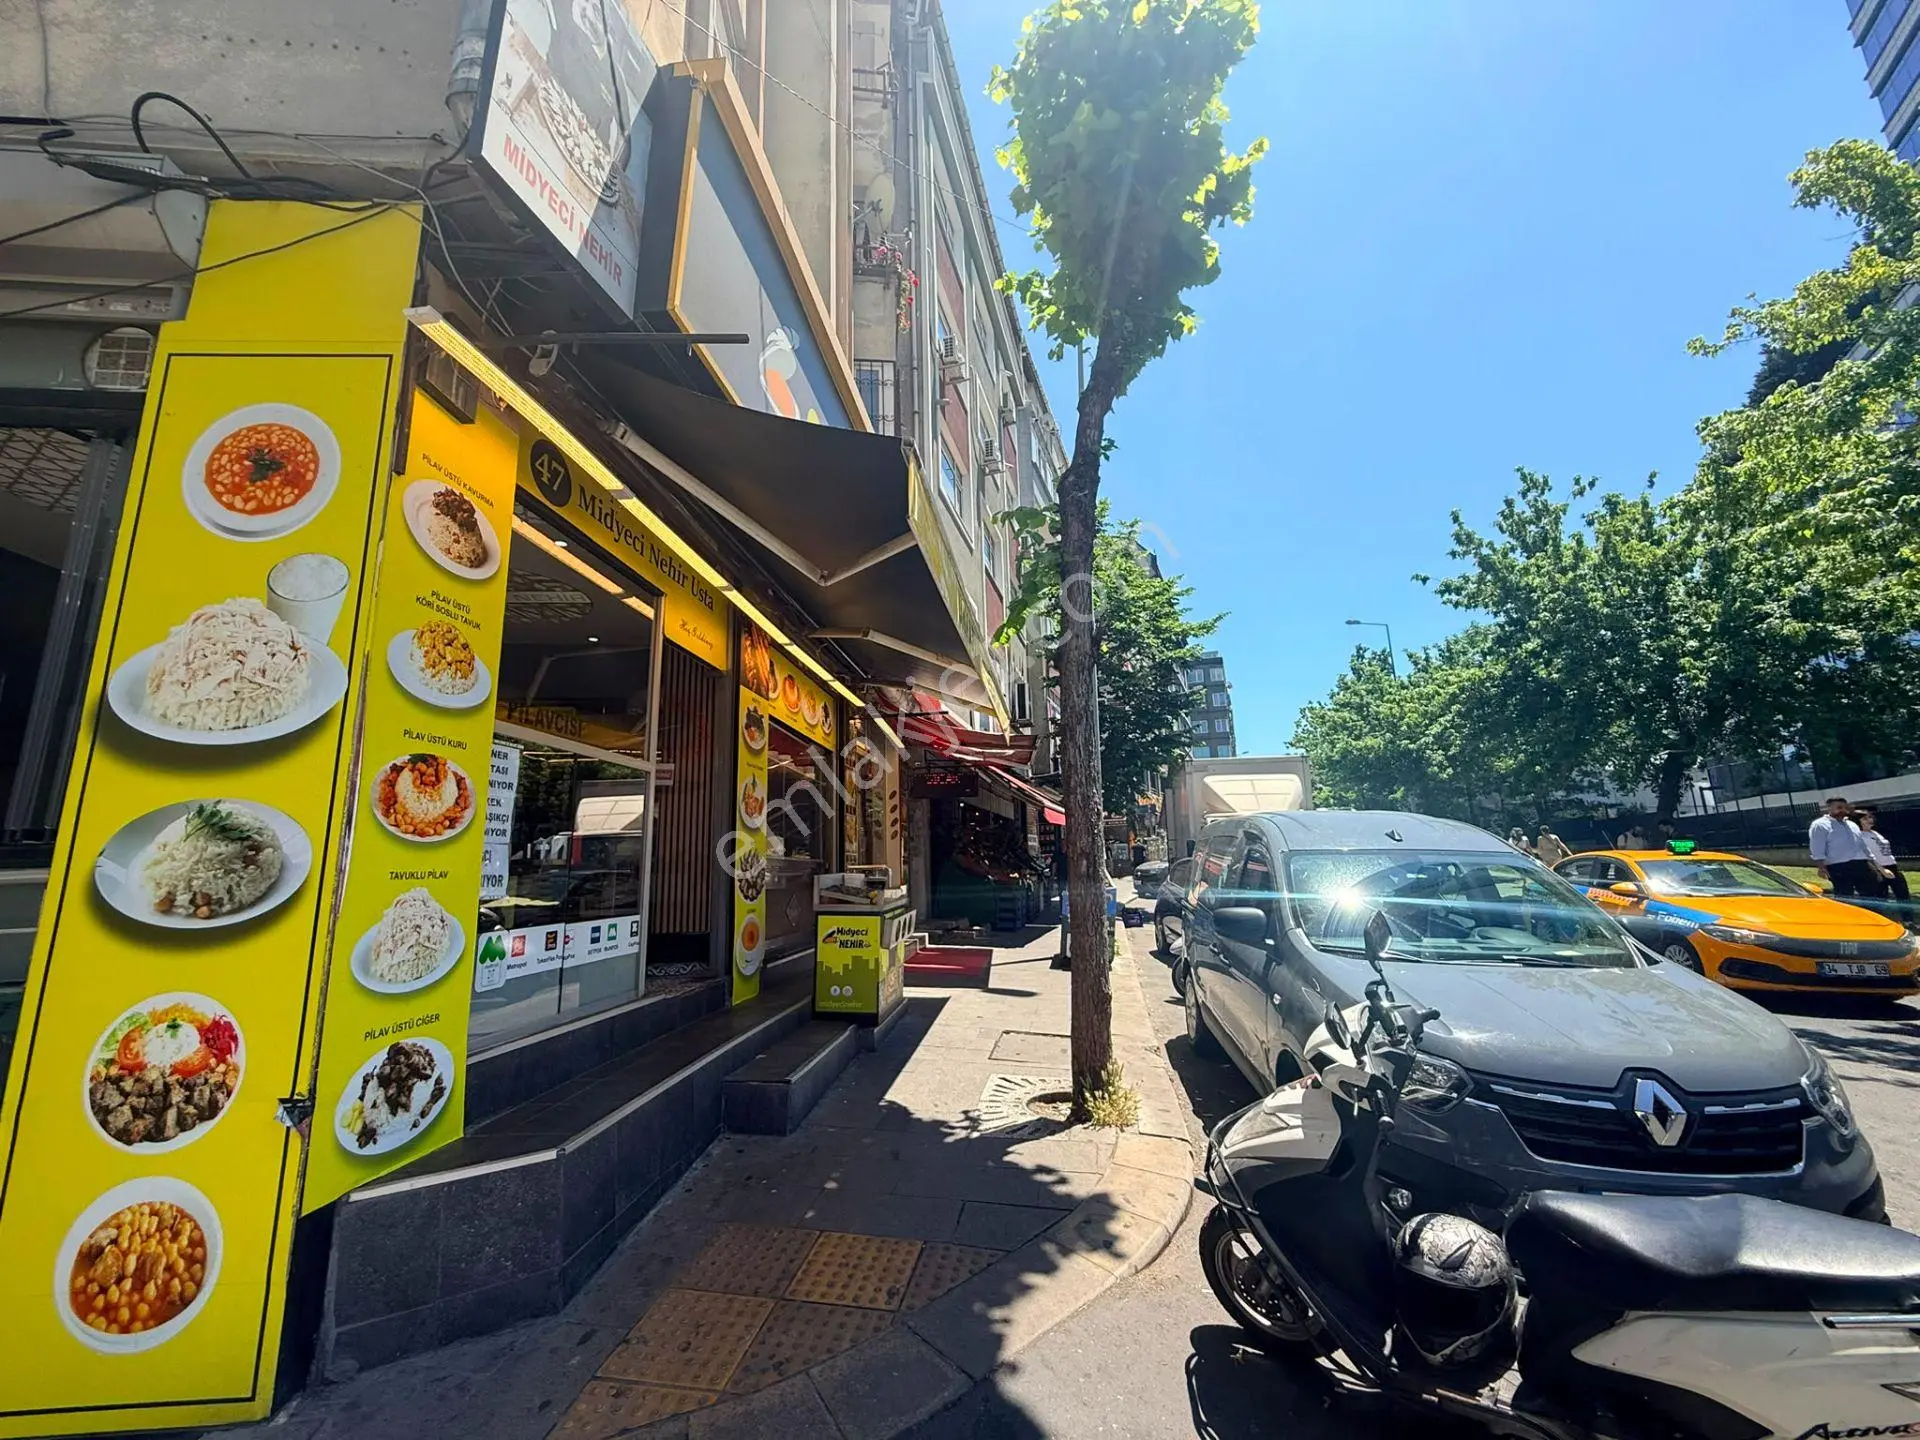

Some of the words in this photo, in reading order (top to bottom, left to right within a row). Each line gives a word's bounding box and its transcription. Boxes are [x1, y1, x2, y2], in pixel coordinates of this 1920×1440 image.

[503, 133, 575, 232] MİDYECİ
[577, 221, 622, 287] NEHİR
[463, 482, 494, 509] KAVURMA
[535, 453, 565, 492] 47
[578, 485, 645, 558] Midyeci
[648, 543, 689, 588] Nehir
[691, 575, 714, 612] Usta
[436, 604, 459, 621] SOSLU
[460, 615, 481, 631] TAVUK
[403, 728, 426, 741] PİLAV
[427, 733, 447, 746] ÜSTÜ
[447, 738, 468, 750] KURU
[389, 871, 426, 880] TAVUKLU
[427, 868, 449, 879] PİLAV
[364, 1027, 391, 1041] PİLAV
[391, 1018, 415, 1034] ÜSTÜ
